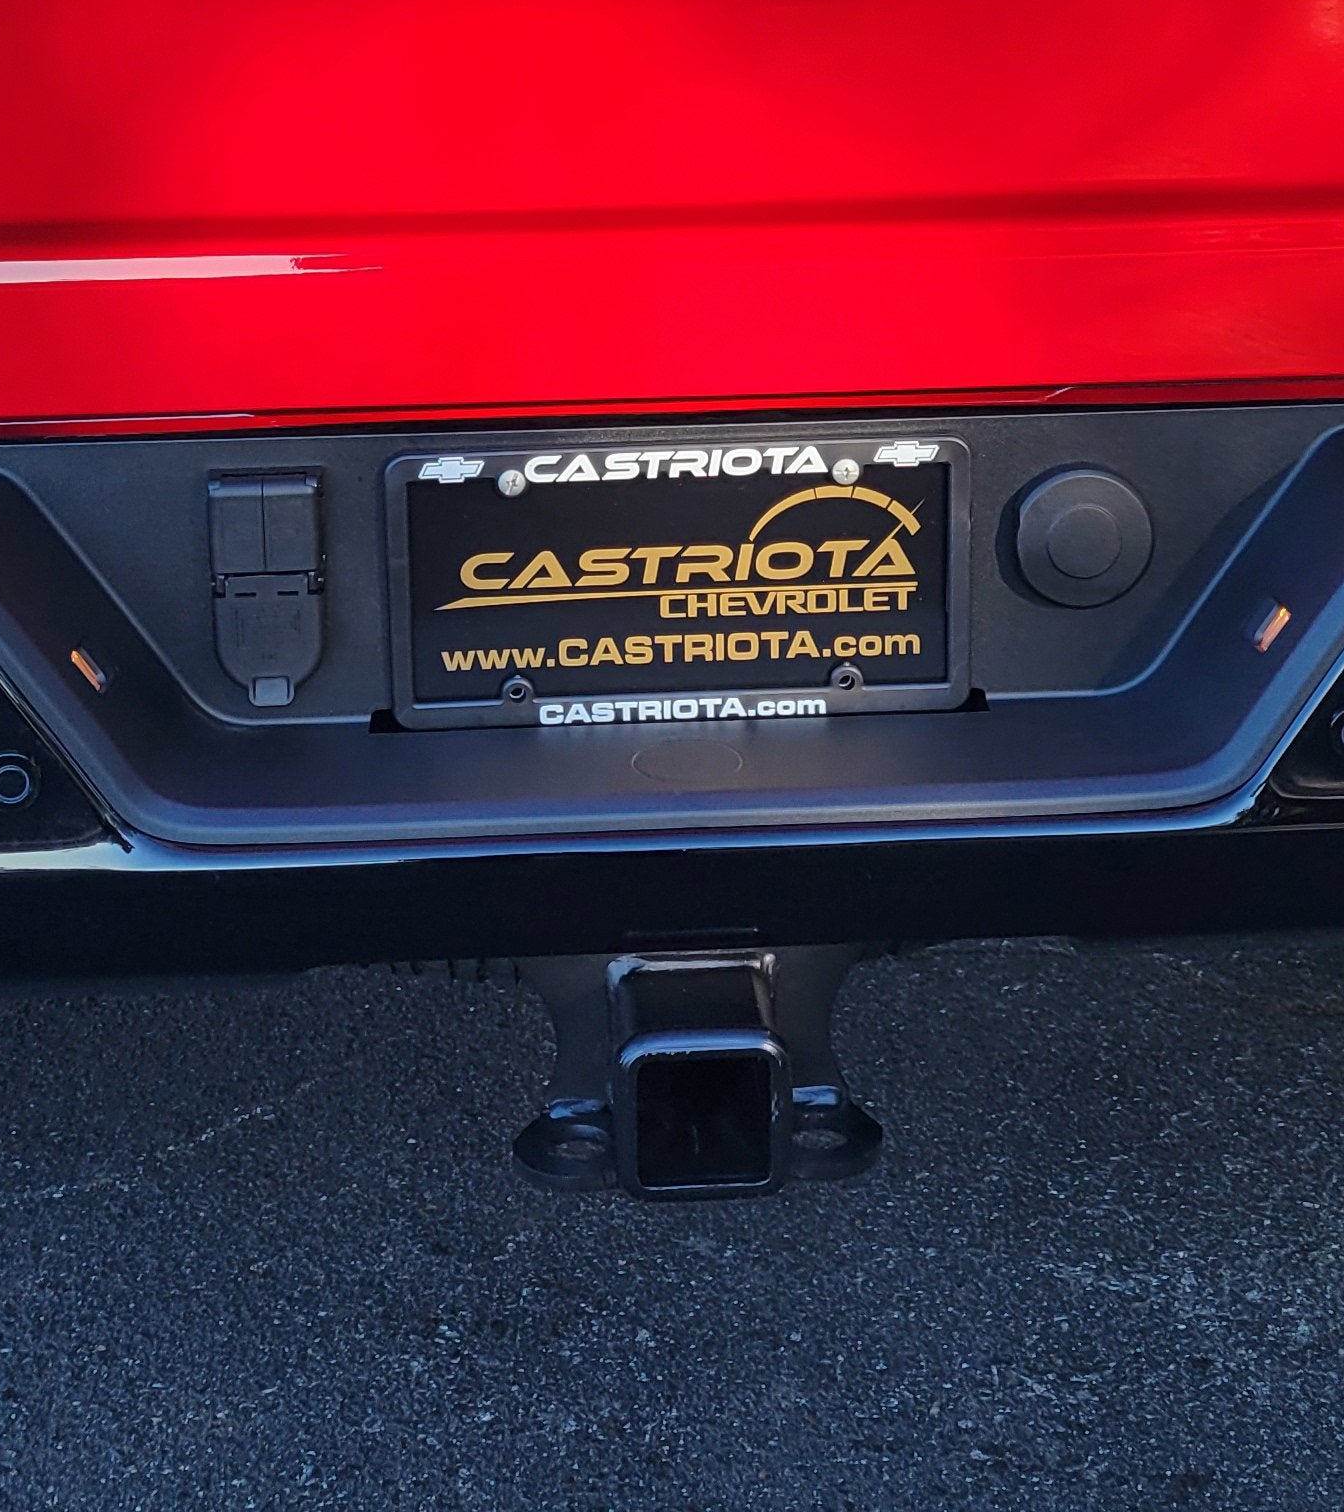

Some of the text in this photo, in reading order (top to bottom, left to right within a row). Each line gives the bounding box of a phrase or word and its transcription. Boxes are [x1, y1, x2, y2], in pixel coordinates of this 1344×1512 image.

[523, 445, 829, 484] CASTRIOTA
[458, 538, 918, 590] CASTRIOTA
[658, 586, 916, 619] CHEVROLET
[440, 630, 921, 672] www.CASTRIOTA.com
[538, 696, 828, 726] CASTRIOTA.com
